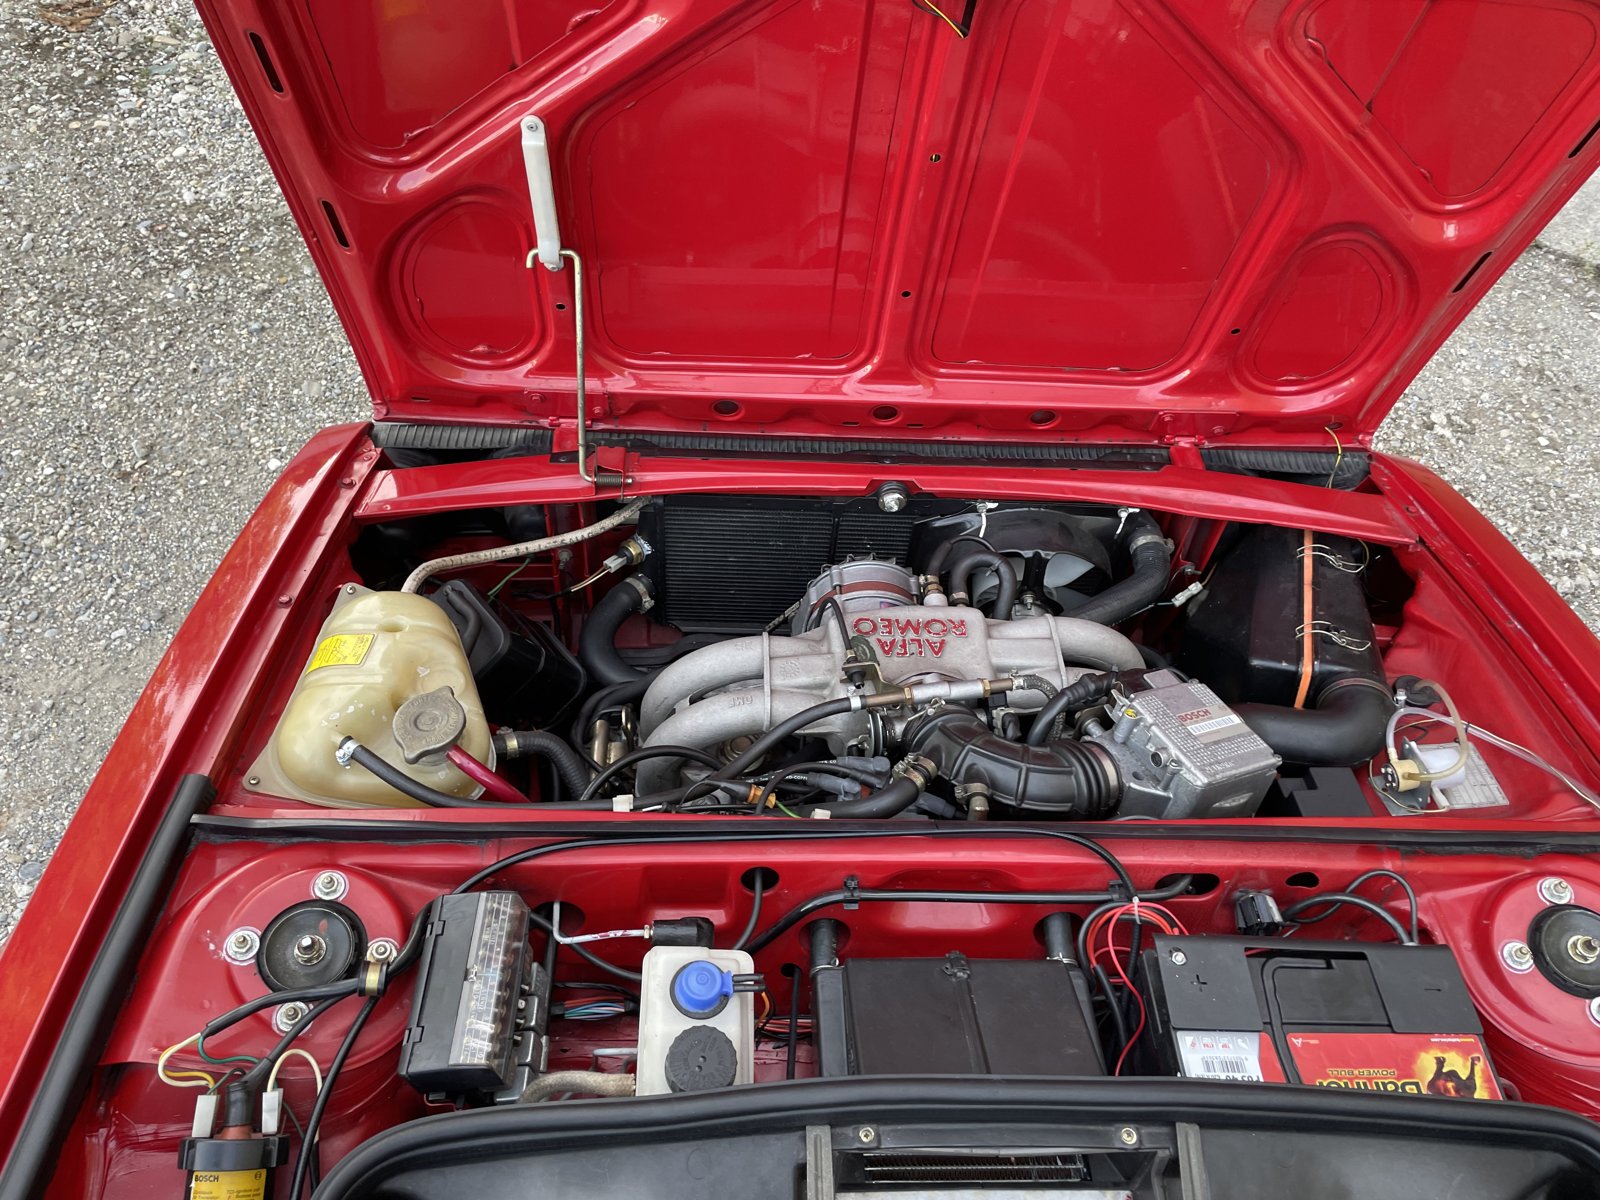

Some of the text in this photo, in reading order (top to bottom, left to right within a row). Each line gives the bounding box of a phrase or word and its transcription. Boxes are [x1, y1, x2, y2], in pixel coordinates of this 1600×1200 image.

[852, 617, 968, 637] ROMEO
[876, 637, 946, 658] ALFA
[1176, 708, 1212, 723] BOSCH
[194, 1174, 219, 1182] BOSCH
